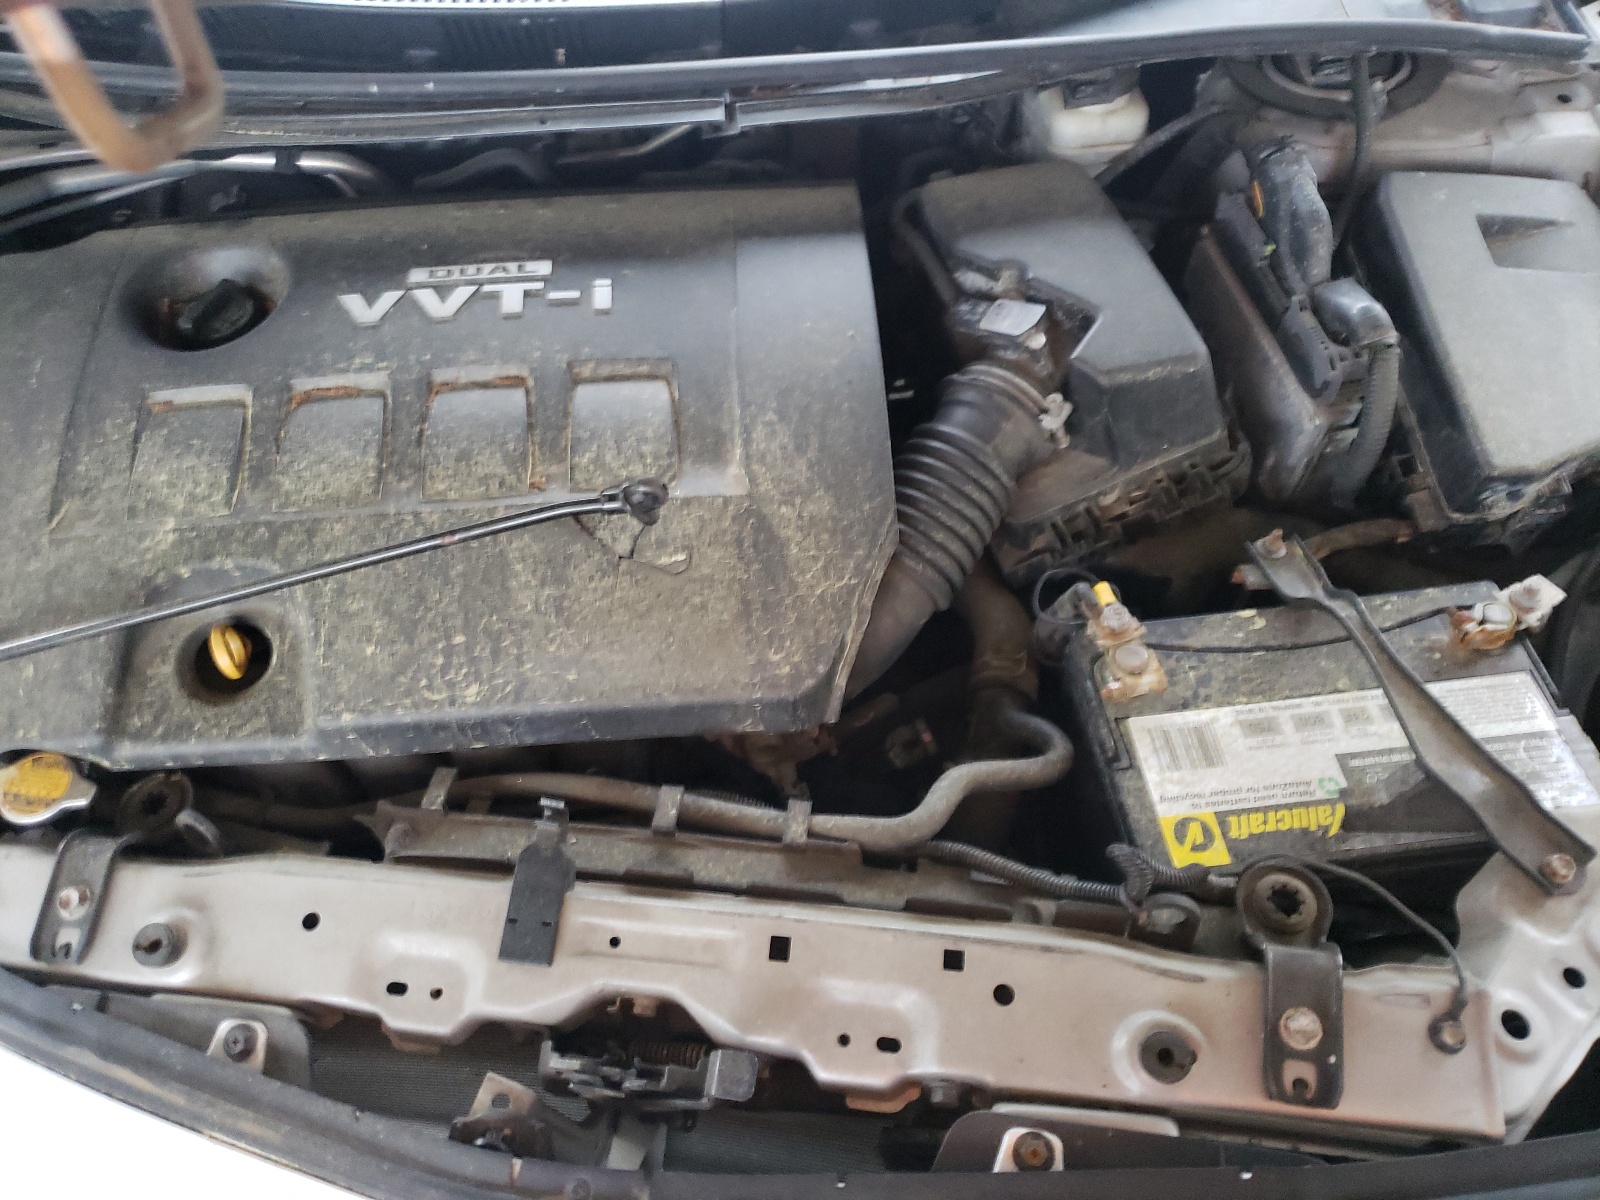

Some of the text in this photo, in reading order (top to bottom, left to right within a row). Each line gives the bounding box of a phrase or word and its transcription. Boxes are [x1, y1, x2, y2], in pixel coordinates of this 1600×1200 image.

[428, 262, 540, 279] DUAL
[337, 278, 613, 326] VVT-i
[1209, 786, 1243, 798] proper
[1262, 780, 1312, 792] AutoZone
[1159, 792, 1207, 804] recycling
[1254, 793, 1278, 804] used
[1281, 789, 1316, 800] Return
[1204, 797, 1251, 809] batteries
